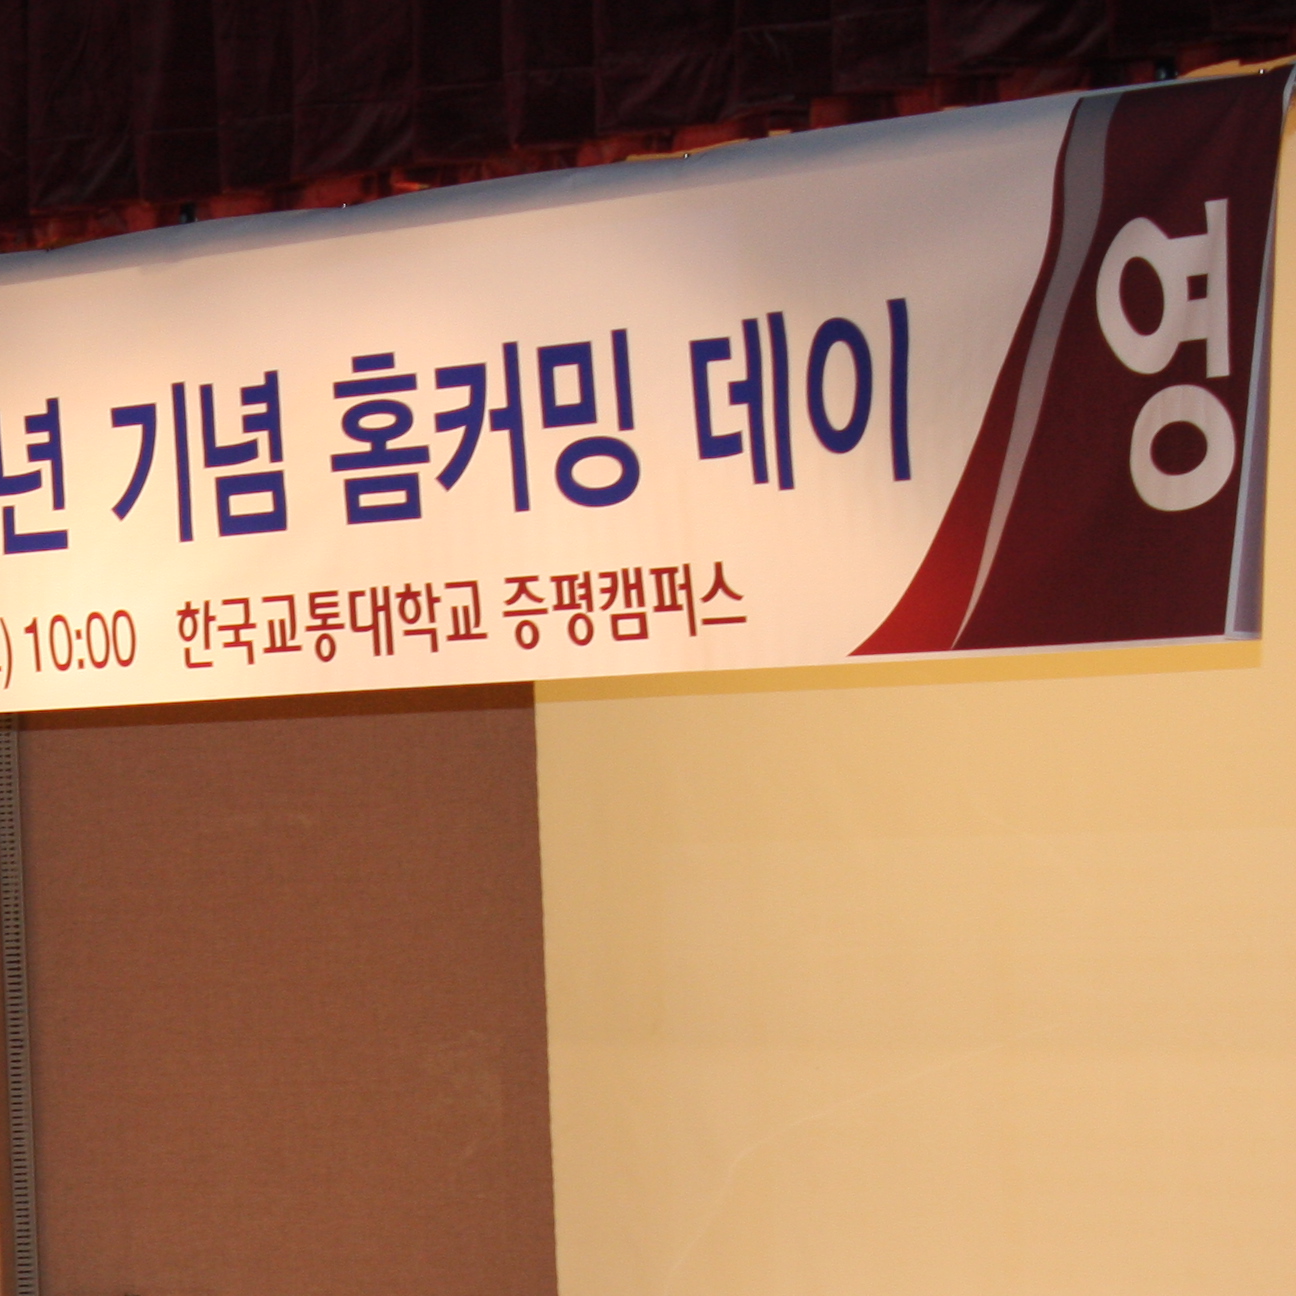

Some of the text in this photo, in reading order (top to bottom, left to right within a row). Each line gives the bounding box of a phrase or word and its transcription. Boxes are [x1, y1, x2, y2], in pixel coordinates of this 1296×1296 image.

[109, 369, 289, 543] 기념
[330, 328, 640, 527] 홈커밍
[689, 296, 911, 491] 데이
[1096, 199, 1237, 512] 영
[177, 578, 488, 670] 한국교통대학교
[502, 560, 748, 650] 증평캠퍼스
